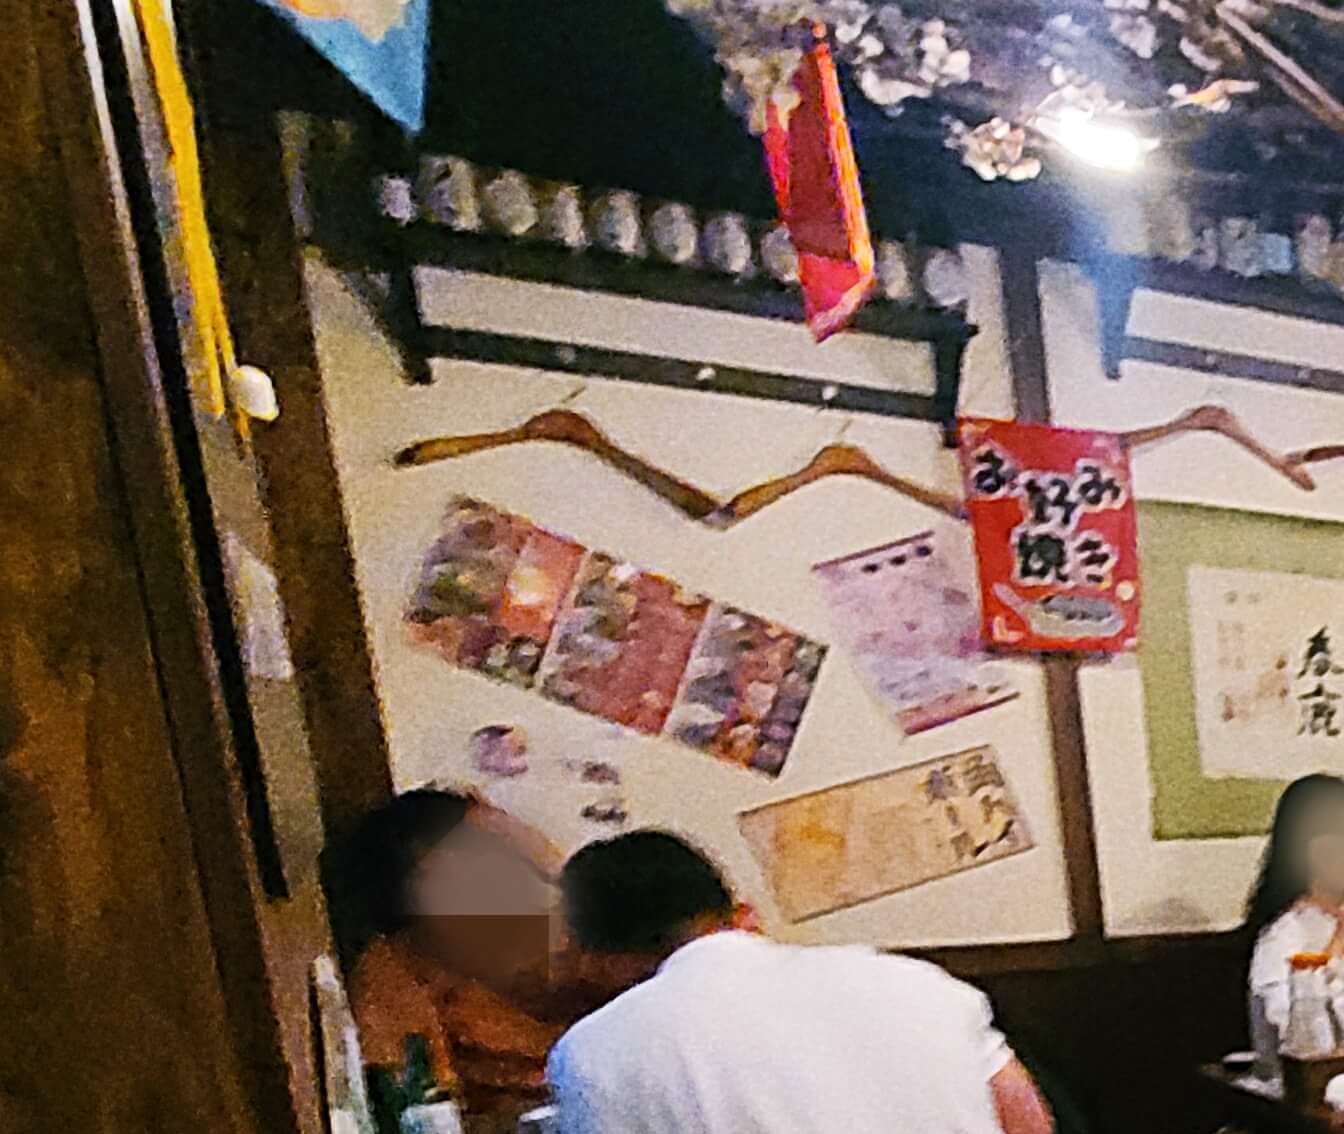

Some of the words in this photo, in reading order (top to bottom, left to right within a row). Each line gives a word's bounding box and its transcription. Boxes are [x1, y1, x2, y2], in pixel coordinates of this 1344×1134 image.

[973, 448, 1125, 526] お好み
[1016, 530, 1113, 584] 焼き
